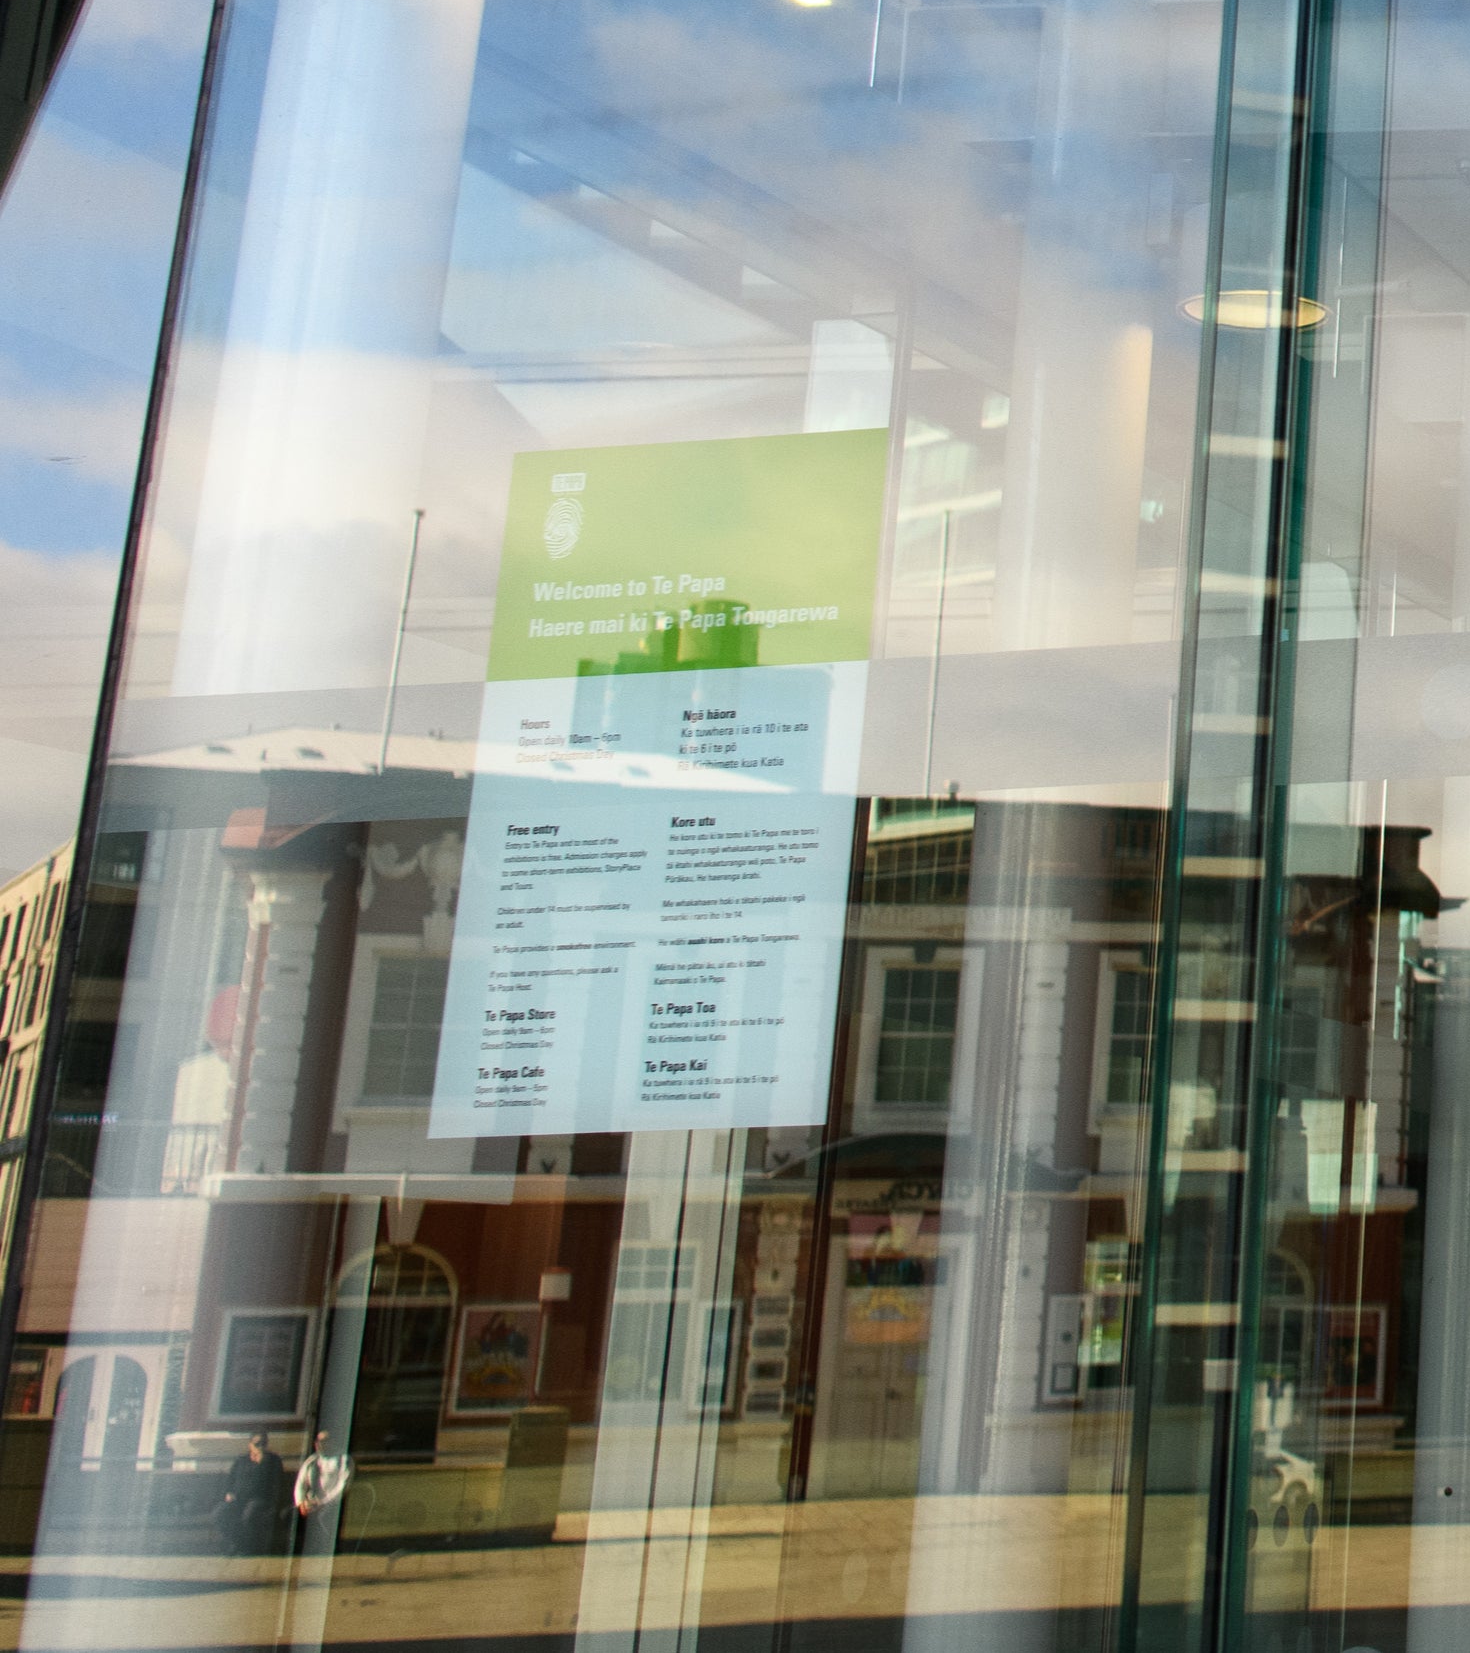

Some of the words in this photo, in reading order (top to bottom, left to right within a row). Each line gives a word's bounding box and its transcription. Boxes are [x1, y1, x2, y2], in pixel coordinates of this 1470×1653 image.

[534, 581, 622, 601] Welcome
[627, 578, 646, 597] to
[652, 576, 672, 594] Te
[678, 574, 725, 597] Papa
[529, 619, 584, 637] Haere
[589, 615, 625, 636] mai
[630, 613, 647, 632] ki
[650, 613, 672, 631] Te
[679, 611, 725, 634] Papa
[732, 604, 838, 627] Tongarewa
[683, 710, 703, 723] Ngā
[707, 708, 736, 721] hāora
[671, 816, 696, 828] Kore
[698, 817, 715, 827] utu
[507, 824, 530, 837] Free
[533, 823, 559, 838] entry
[485, 1009, 497, 1022] Te
[499, 1008, 525, 1024] Papa
[528, 1009, 555, 1020] Store
